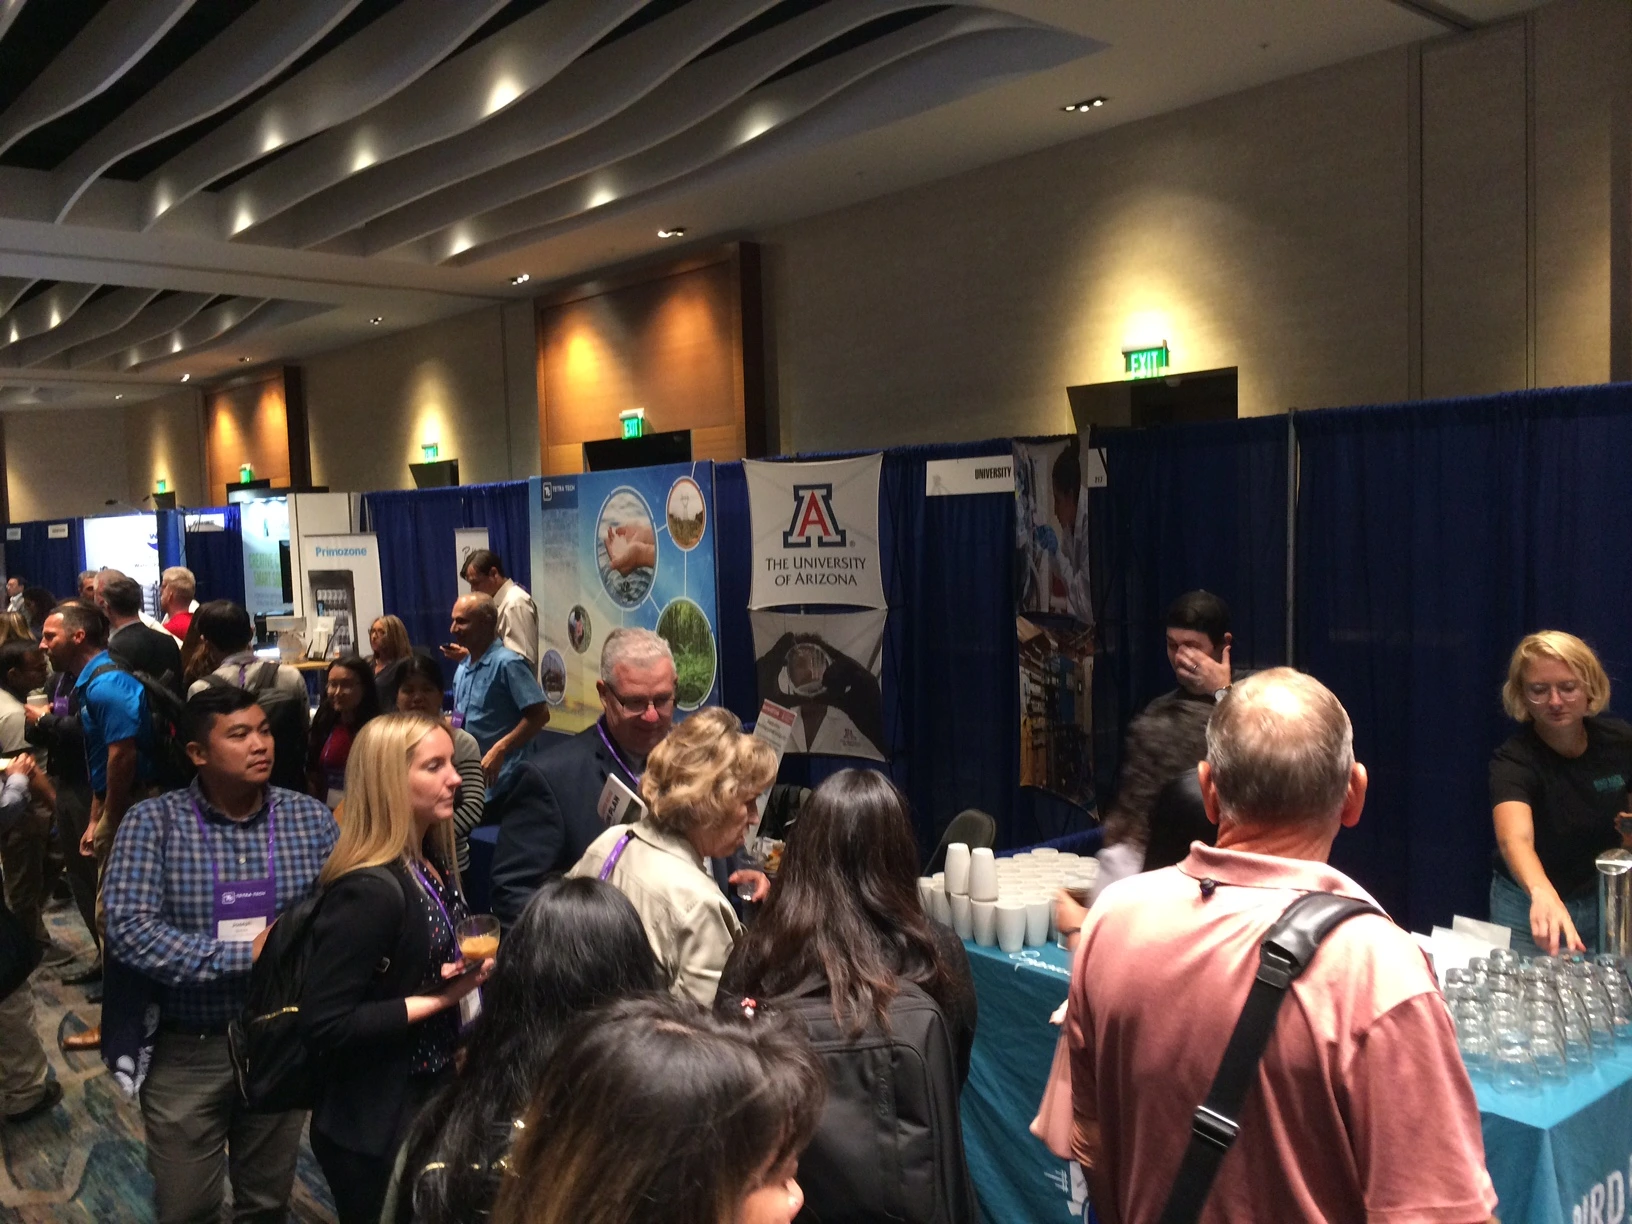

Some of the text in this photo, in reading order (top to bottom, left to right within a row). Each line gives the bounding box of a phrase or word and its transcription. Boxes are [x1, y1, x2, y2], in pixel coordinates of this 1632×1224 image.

[1131, 350, 1158, 379] EXIT
[624, 419, 638, 438] EXIT
[975, 466, 1012, 480] UNIVERSITY
[783, 483, 847, 549] A
[315, 546, 368, 558] Primozone
[765, 556, 867, 571] THE UNIVERSITY
[774, 571, 858, 586] OF ARIZONA
